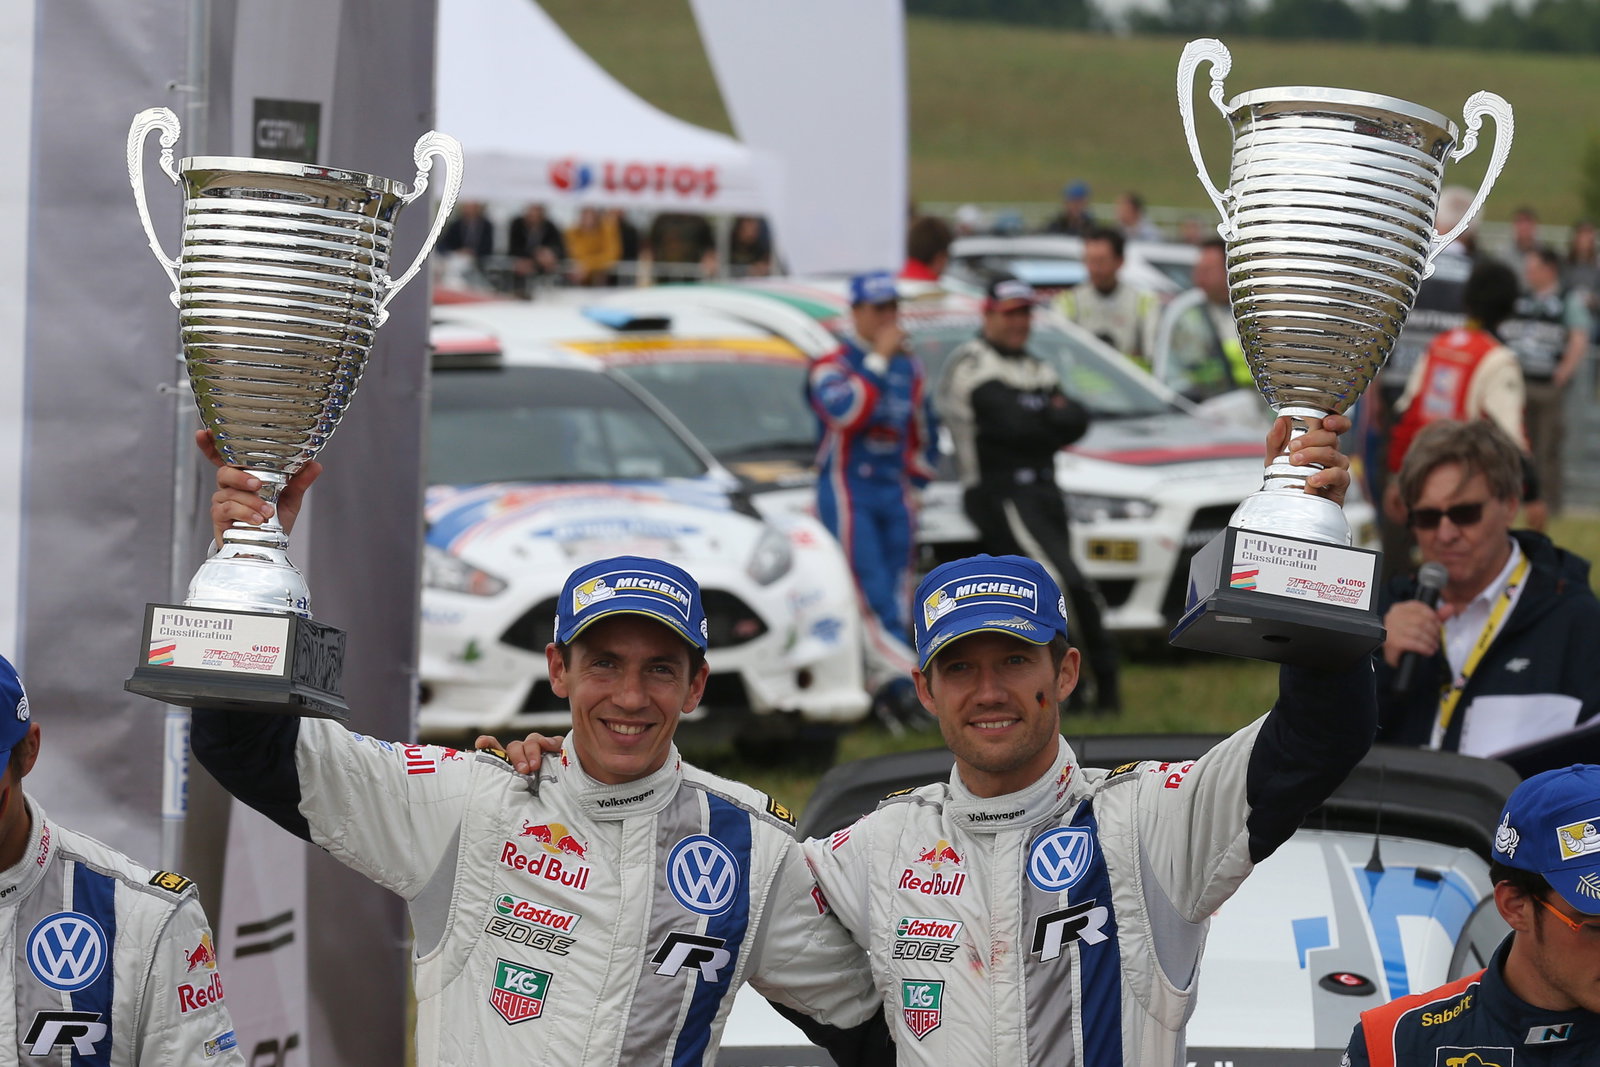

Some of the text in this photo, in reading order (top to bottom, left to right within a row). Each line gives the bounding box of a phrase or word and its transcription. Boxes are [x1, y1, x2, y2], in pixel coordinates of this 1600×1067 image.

[603, 163, 718, 198] LOTOS
[1242, 551, 1317, 571] Classification
[615, 578, 688, 606] MICHELIN
[955, 582, 1033, 600] MICHELIN
[1328, 584, 1363, 598] Poland
[1346, 579, 1366, 588] LOTOS
[160, 627, 232, 641] Classification
[242, 652, 277, 664] Poland
[260, 645, 280, 654] LOTOS
[597, 789, 654, 808] Volkswagen
[968, 808, 1026, 822] Volkswagen
[513, 902, 573, 931] Castrol
[485, 916, 577, 956] EDGE
[907, 920, 958, 939] Castrol
[892, 941, 960, 962] EDGE
[504, 967, 539, 995] TAG
[493, 990, 537, 1018] HEUER
[907, 985, 934, 1007] TAG
[1421, 995, 1473, 1027] Sabelt
[906, 1011, 939, 1037] HEUER
